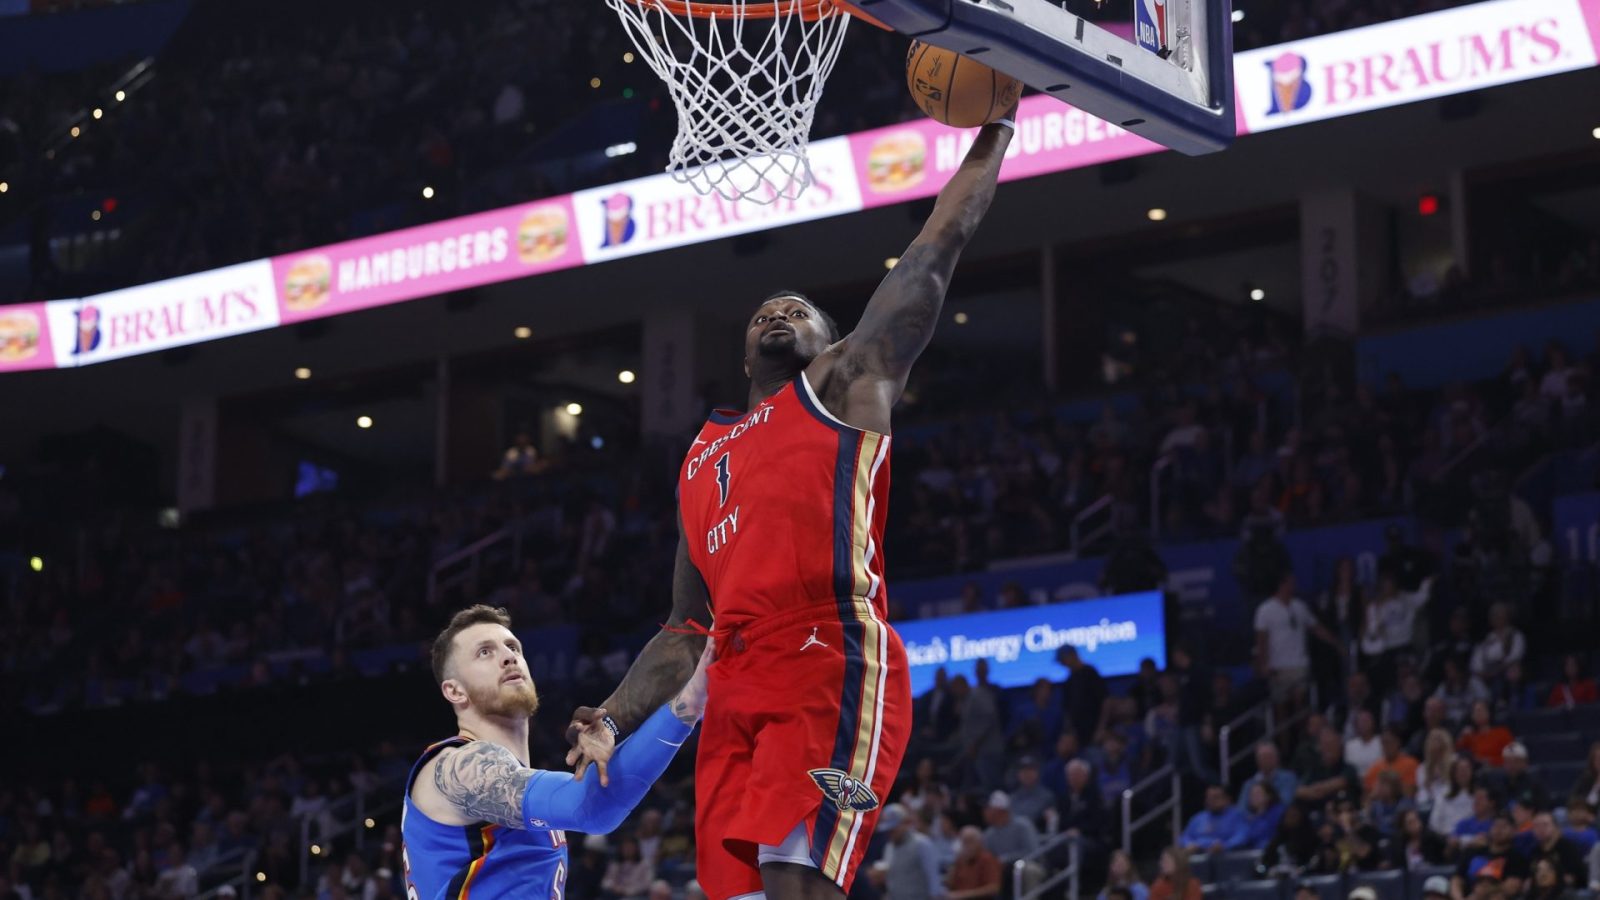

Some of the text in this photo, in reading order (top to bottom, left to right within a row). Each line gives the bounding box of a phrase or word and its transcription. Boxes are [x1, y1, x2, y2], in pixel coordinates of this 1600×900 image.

[1140, 21, 1155, 48] NBA
[1322, 18, 1562, 107] BRAUM'S
[338, 228, 509, 294] HAMBURGERS
[108, 283, 260, 349] BRAUM'S
[714, 451, 731, 508] 1
[706, 505, 740, 555] CITY
[950, 634, 1023, 663] Energy
[1024, 618, 1137, 653] Champion
